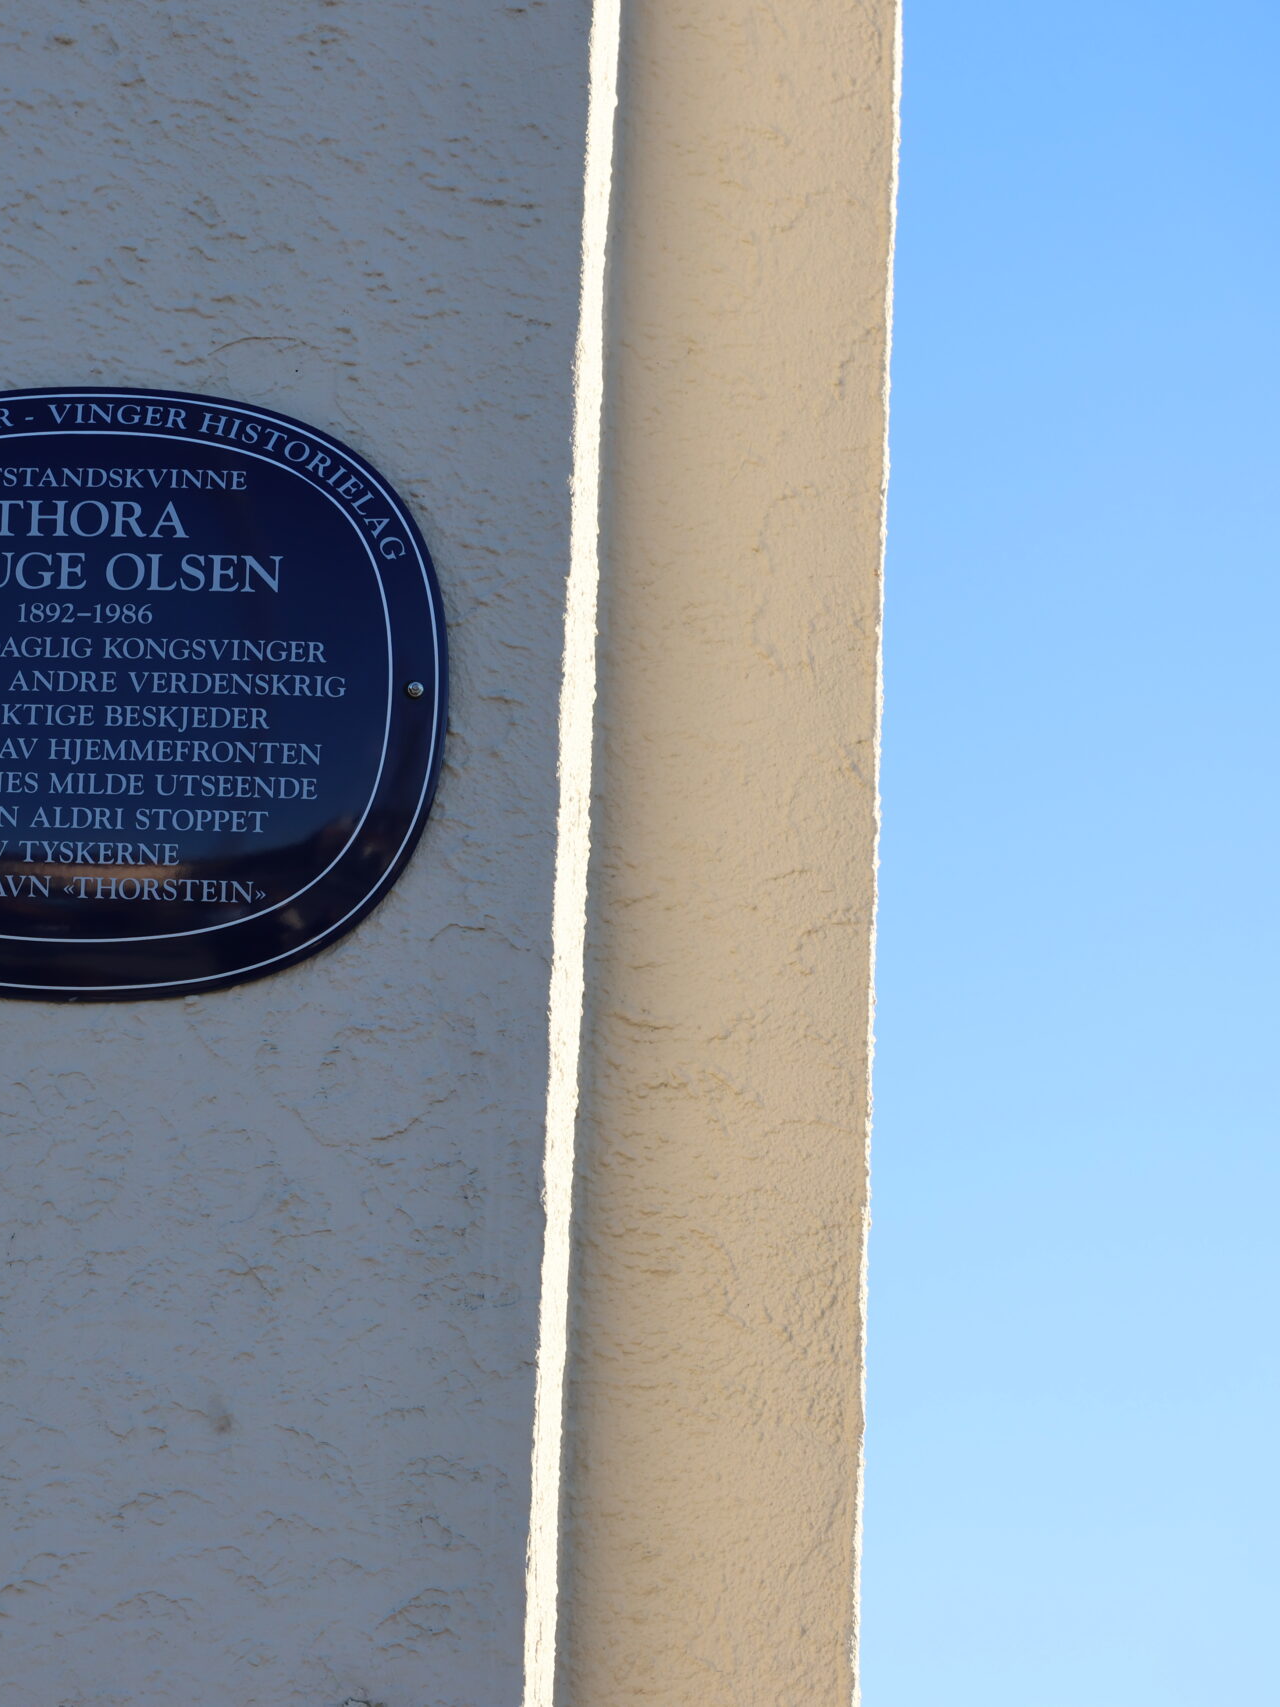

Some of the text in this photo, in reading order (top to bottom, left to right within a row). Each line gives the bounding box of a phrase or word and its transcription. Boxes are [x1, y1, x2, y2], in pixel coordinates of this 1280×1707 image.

[48, 402, 188, 432] VINGER
[200, 412, 407, 563] HISTORIELAG
[105, 552, 284, 593] OLSEN
[103, 637, 327, 663] KONGSVINGER
[8, 670, 117, 693] ANDRE
[128, 671, 347, 698] VERDENSKRIG
[104, 705, 270, 732] BESKJEDER
[48, 738, 322, 766] HJEMMEFRONTEN
[48, 772, 145, 796] MILDE
[155, 774, 318, 800] UTSEENDE
[30, 806, 124, 830] ALDRI
[135, 808, 269, 833] STOPPET
[18, 840, 180, 866] TYSKERNE
